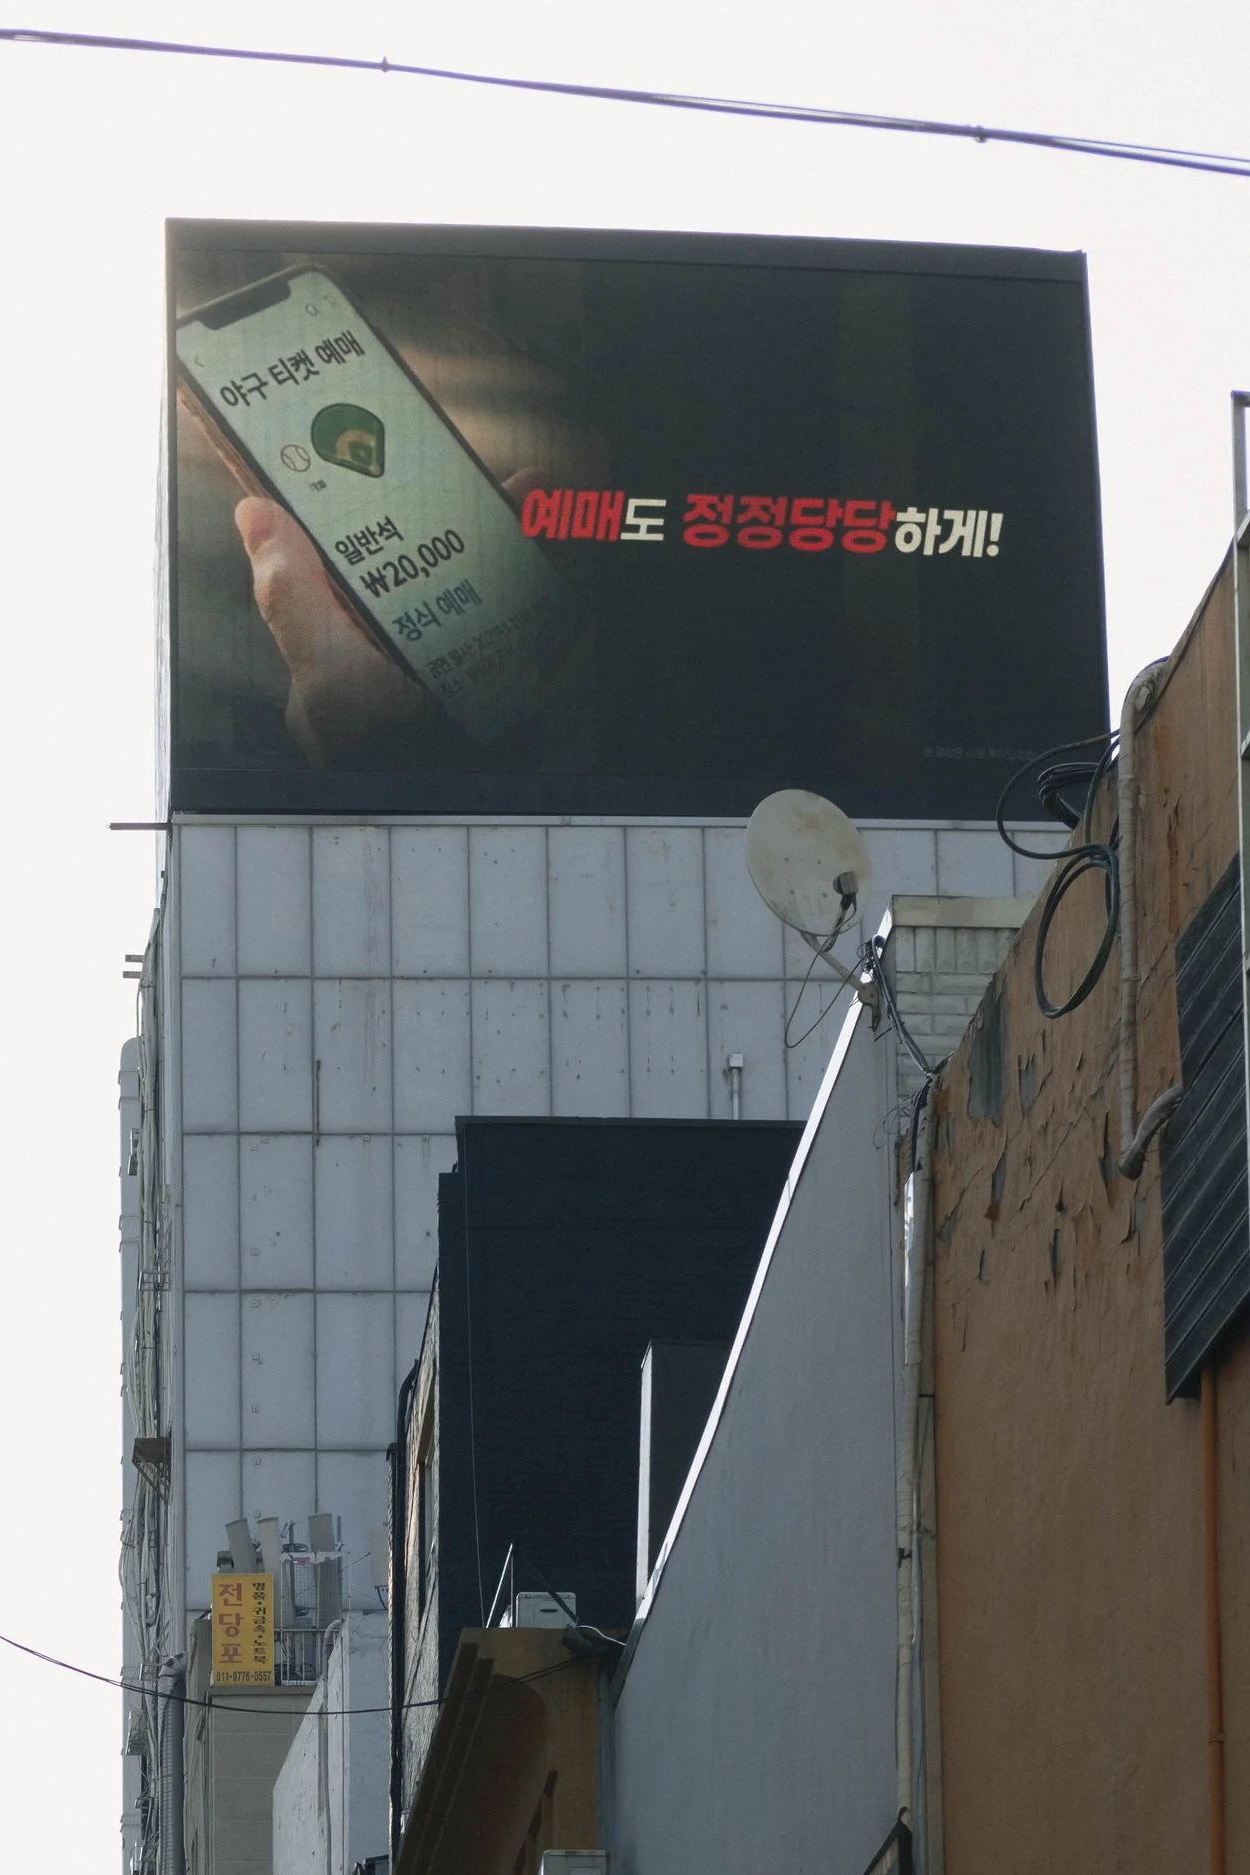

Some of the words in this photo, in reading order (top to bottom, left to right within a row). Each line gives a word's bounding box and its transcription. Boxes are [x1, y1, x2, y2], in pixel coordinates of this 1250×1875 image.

[219, 372, 270, 408] 야구
[268, 352, 321, 387] 티켓
[316, 329, 367, 369] 예매
[334, 515, 405, 566] 일반석
[521, 488, 667, 545] 예매도
[682, 491, 1004, 559] 정정당당하게!
[359, 529, 466, 600] ₩20,000
[391, 600, 442, 643] 정식
[437, 578, 485, 617] 예매
[218, 1582, 245, 1664] 전당포
